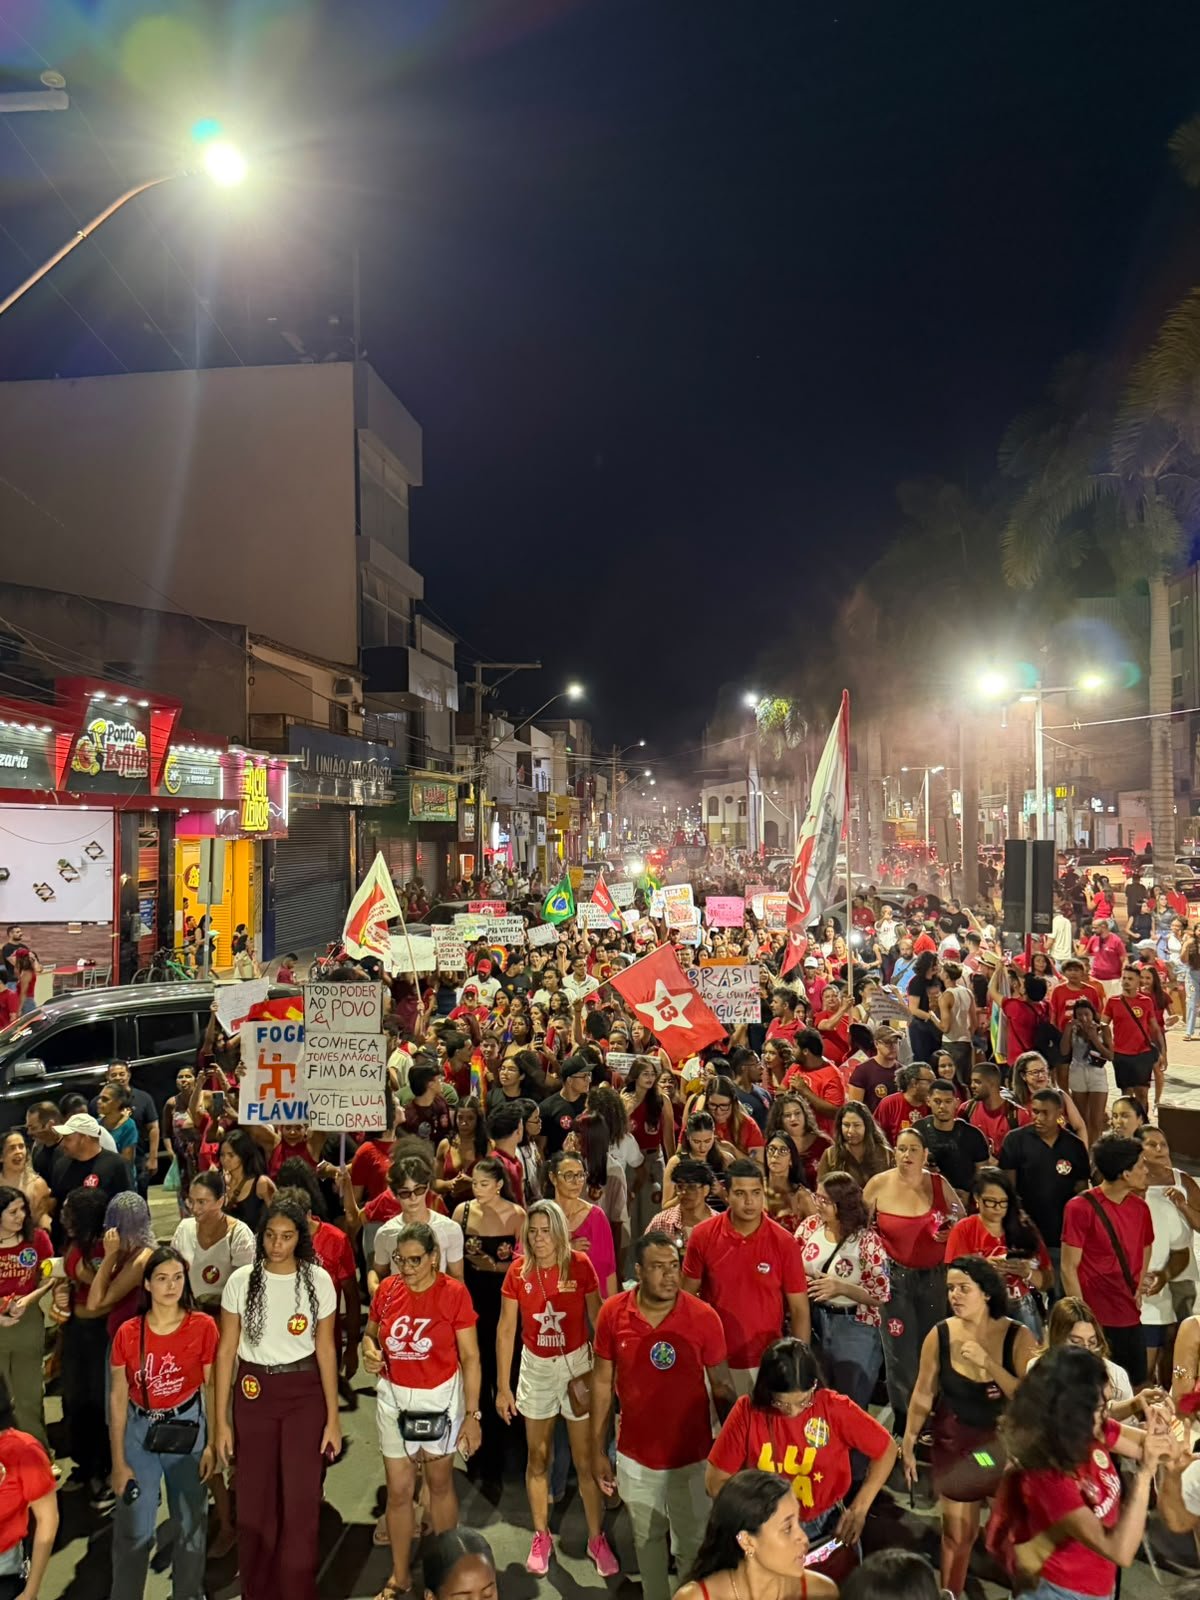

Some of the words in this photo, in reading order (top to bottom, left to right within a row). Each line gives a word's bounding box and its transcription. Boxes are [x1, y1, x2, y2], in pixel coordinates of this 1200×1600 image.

[316, 754, 345, 777] UNIÃO
[347, 761, 392, 784] ATACADISTA
[687, 967, 759, 988] BRASIL
[306, 985, 339, 997] TODO
[339, 984, 377, 998] PODER
[309, 997, 327, 1009] AO
[331, 999, 376, 1021] POVO
[655, 996, 679, 1022] 13
[309, 1036, 379, 1053] CONHEÇA
[306, 1051, 340, 1062] JONES
[341, 1051, 384, 1064] MANOEL
[307, 1063, 337, 1079] FIM
[339, 1063, 356, 1078] DA
[360, 1064, 383, 1082] 6x1
[309, 1092, 349, 1109] VOTE
[351, 1094, 384, 1107] LULA
[309, 1110, 345, 1127] PELO
[290, 1319, 306, 1331] 13
[543, 1315, 557, 1328] PT
[244, 1380, 258, 1393] 13
